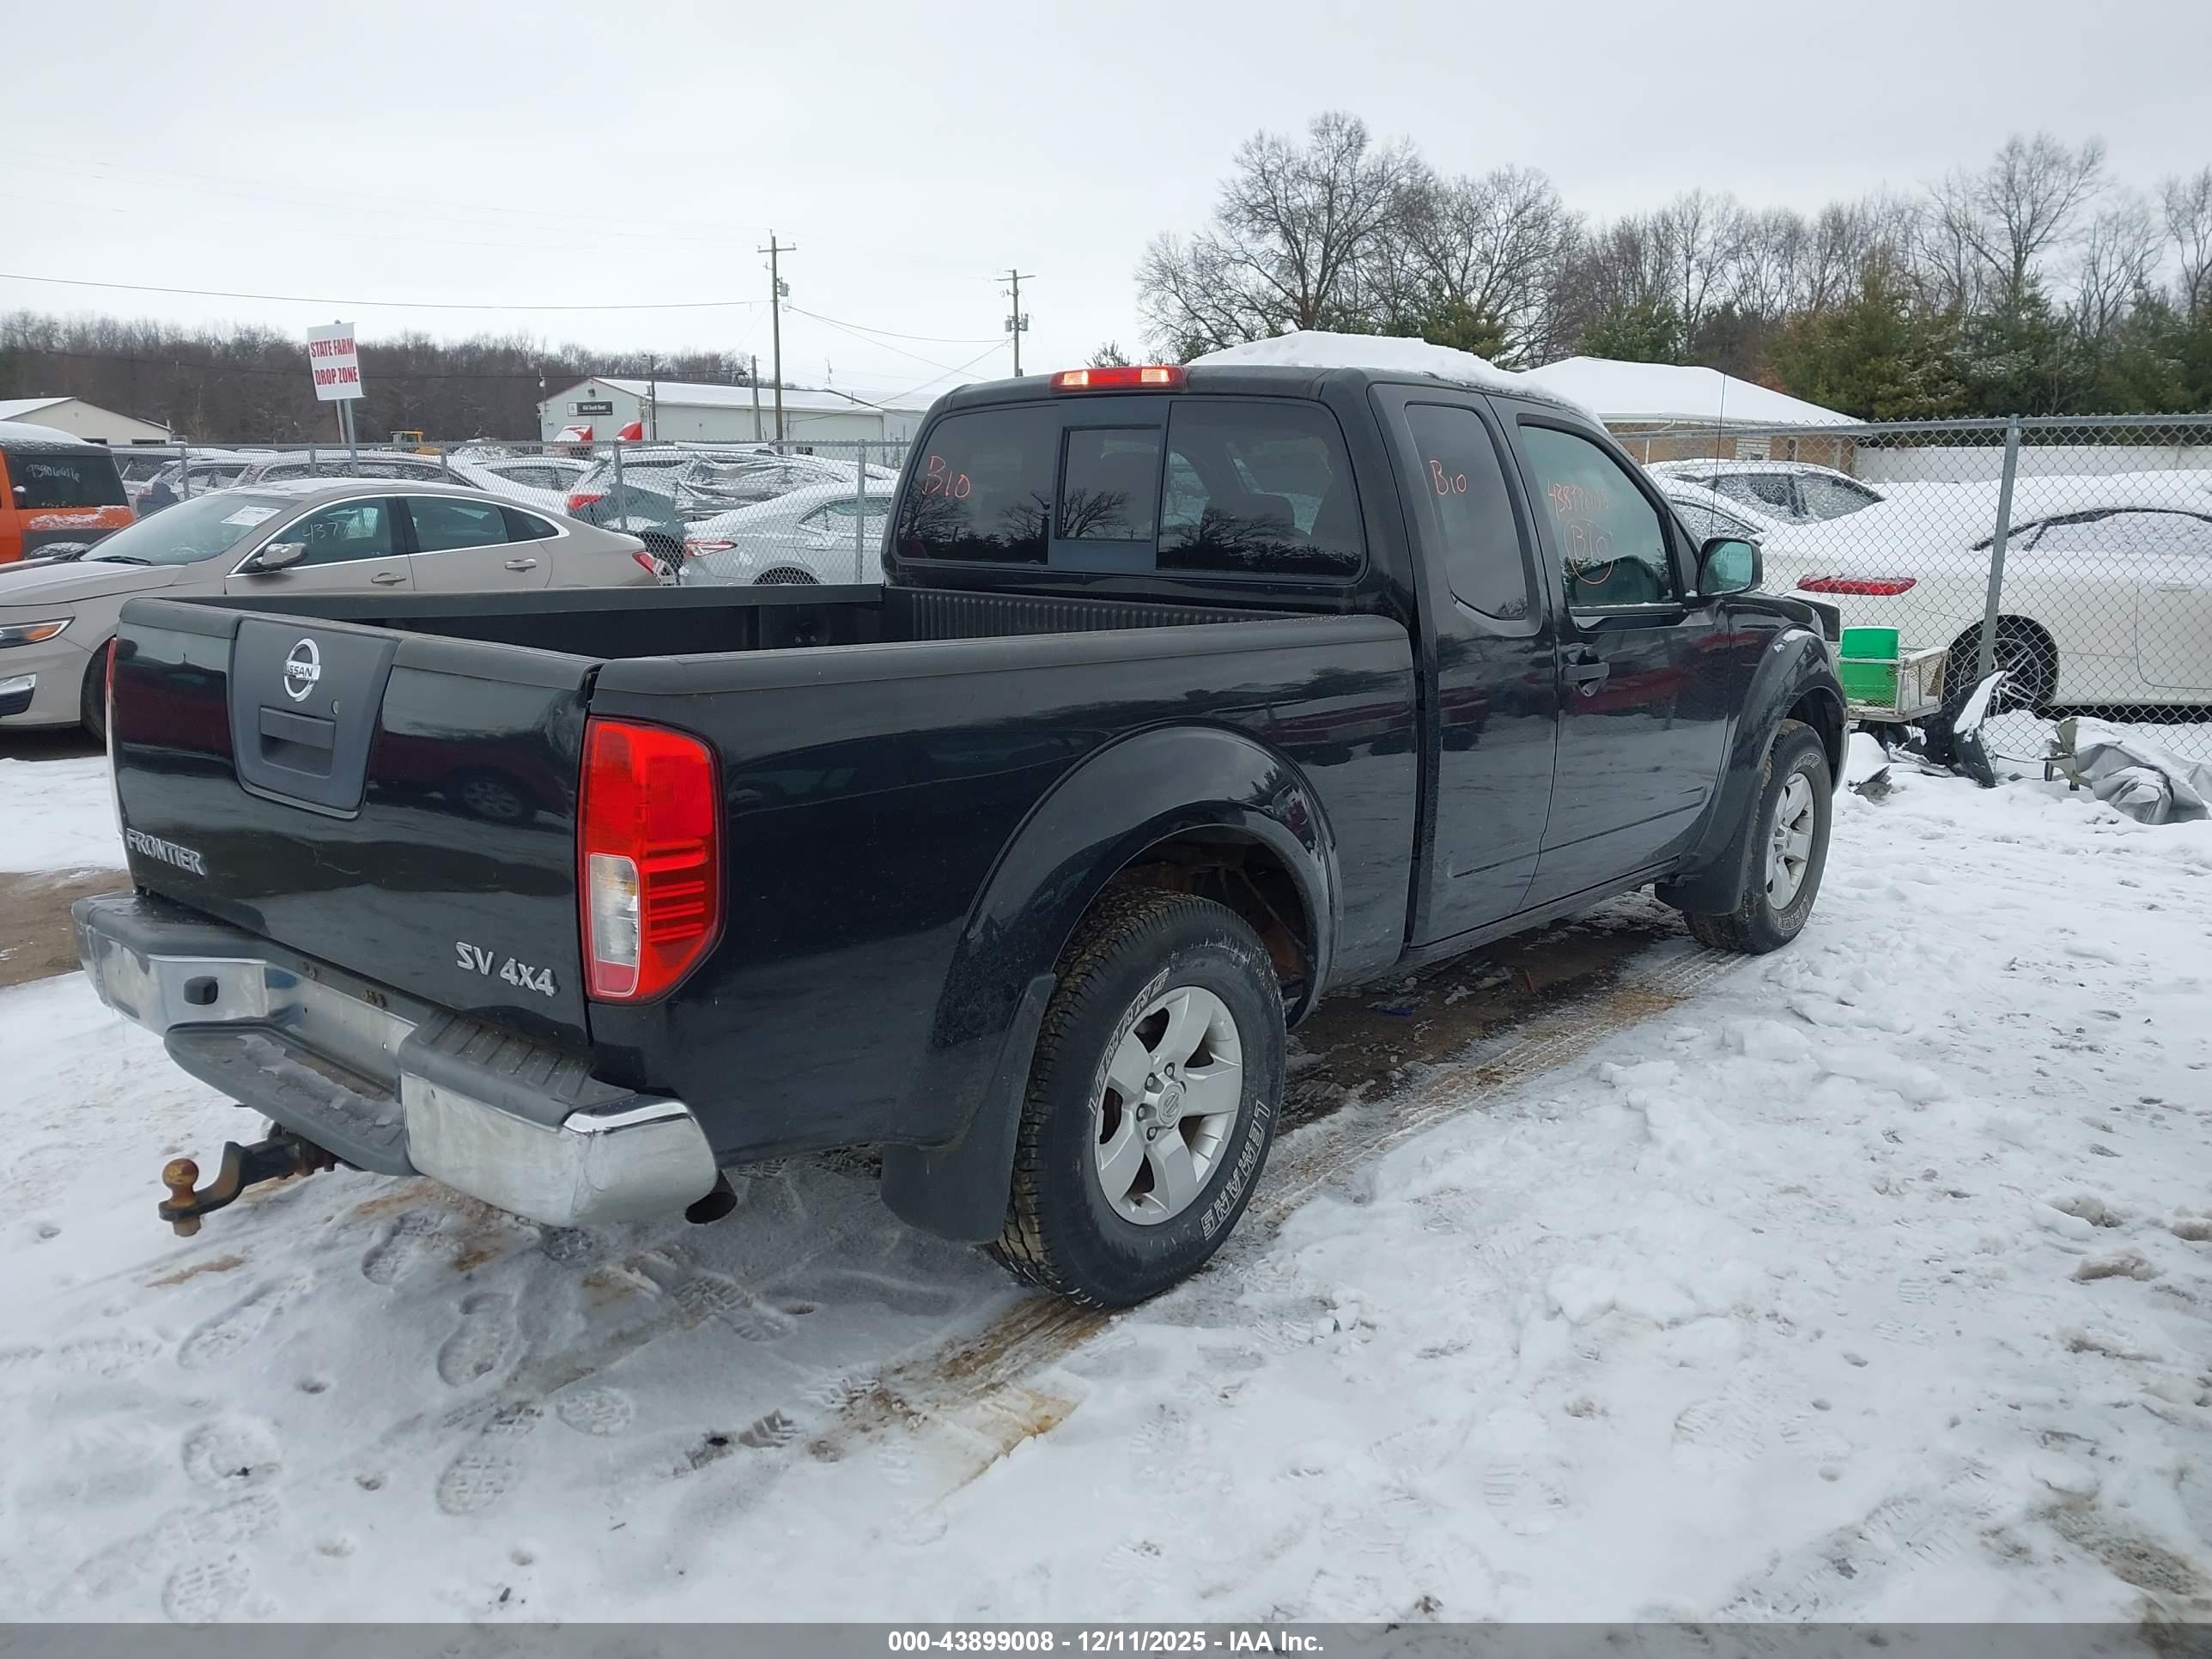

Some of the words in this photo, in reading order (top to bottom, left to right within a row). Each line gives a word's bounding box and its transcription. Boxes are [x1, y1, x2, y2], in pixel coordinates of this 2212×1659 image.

[310, 338, 333, 358] STATE
[333, 337, 355, 356] FARM
[314, 368, 337, 386] DROP
[337, 366, 358, 384] ZONE
[125, 827, 205, 876] FRONTIER
[455, 941, 494, 976] SV
[1200, 1098, 1271, 1241] LEMANS
